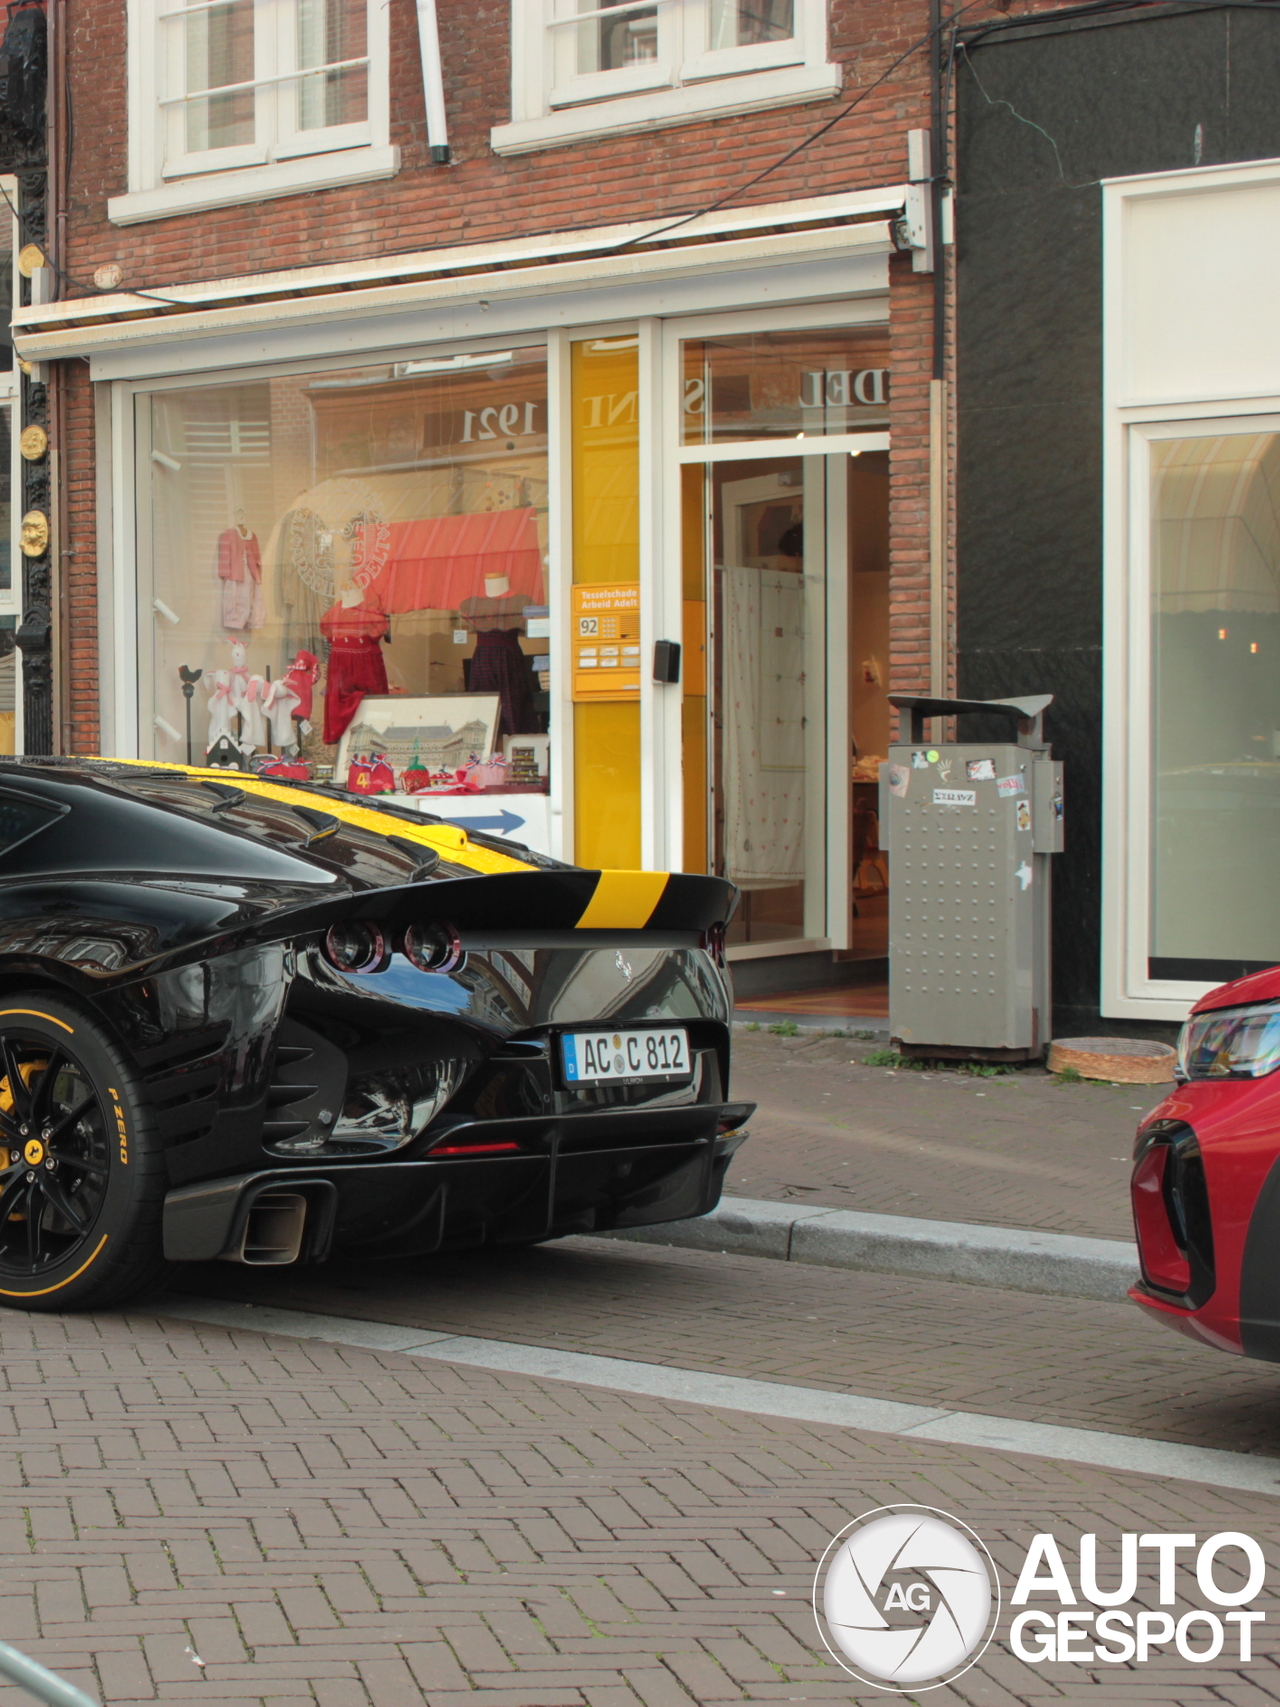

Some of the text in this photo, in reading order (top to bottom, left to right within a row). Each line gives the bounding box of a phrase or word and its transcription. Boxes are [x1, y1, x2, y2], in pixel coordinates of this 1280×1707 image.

[581, 588, 638, 600] Tesselschade
[581, 598, 638, 609] Arbeid Adelt
[581, 619, 598, 634] 92
[356, 772, 368, 789] 4
[585, 1035, 684, 1074] AC C 812
[568, 1063, 575, 1073] D
[108, 1087, 129, 1165] P ZERO
